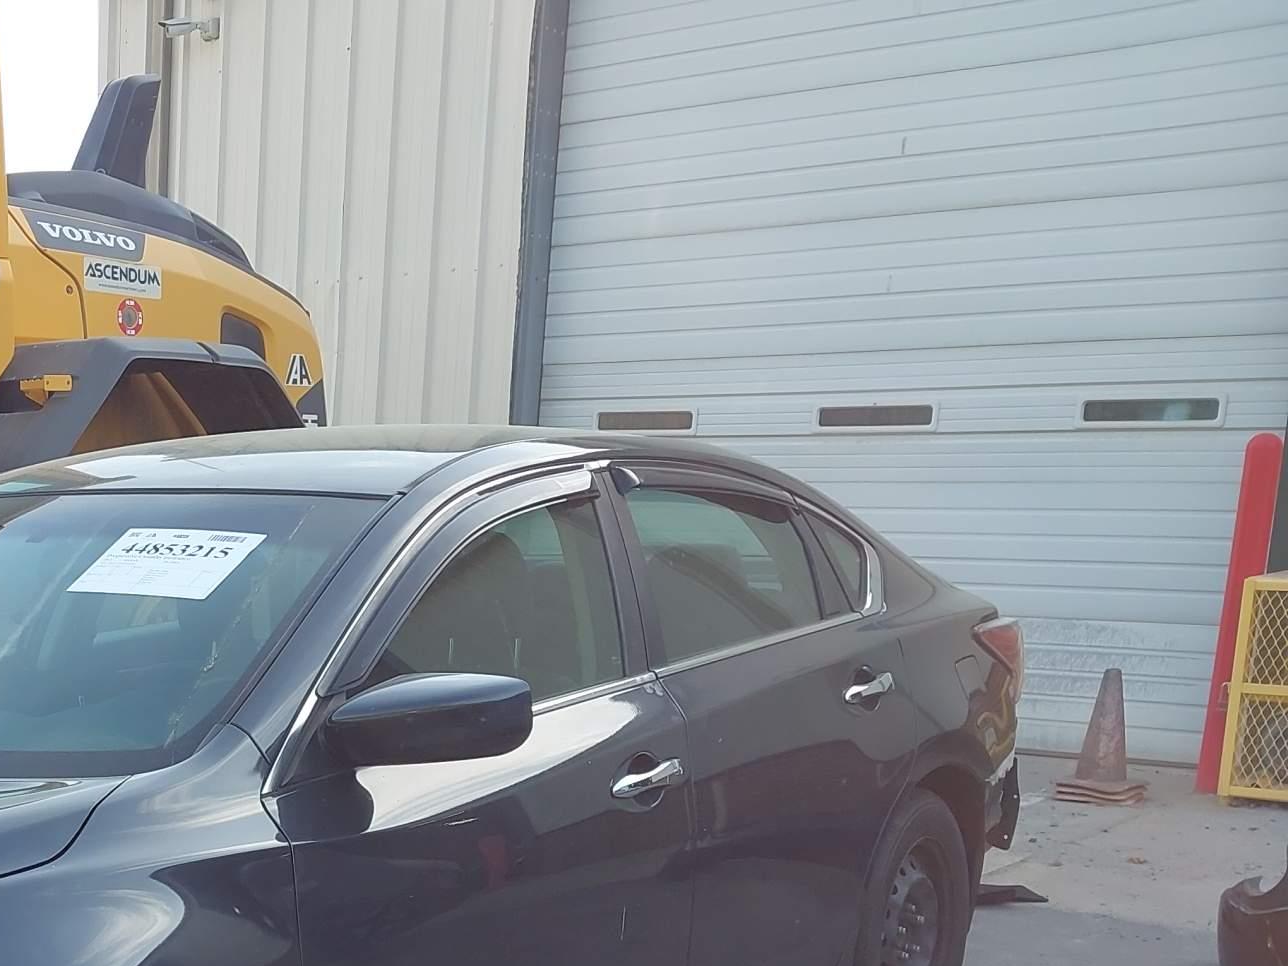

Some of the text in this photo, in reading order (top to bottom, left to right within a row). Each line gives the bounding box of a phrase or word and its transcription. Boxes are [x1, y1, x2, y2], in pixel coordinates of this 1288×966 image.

[37, 221, 136, 251] VOLVO
[84, 262, 160, 287] ASCENDUM
[121, 542, 234, 559] 44853215
